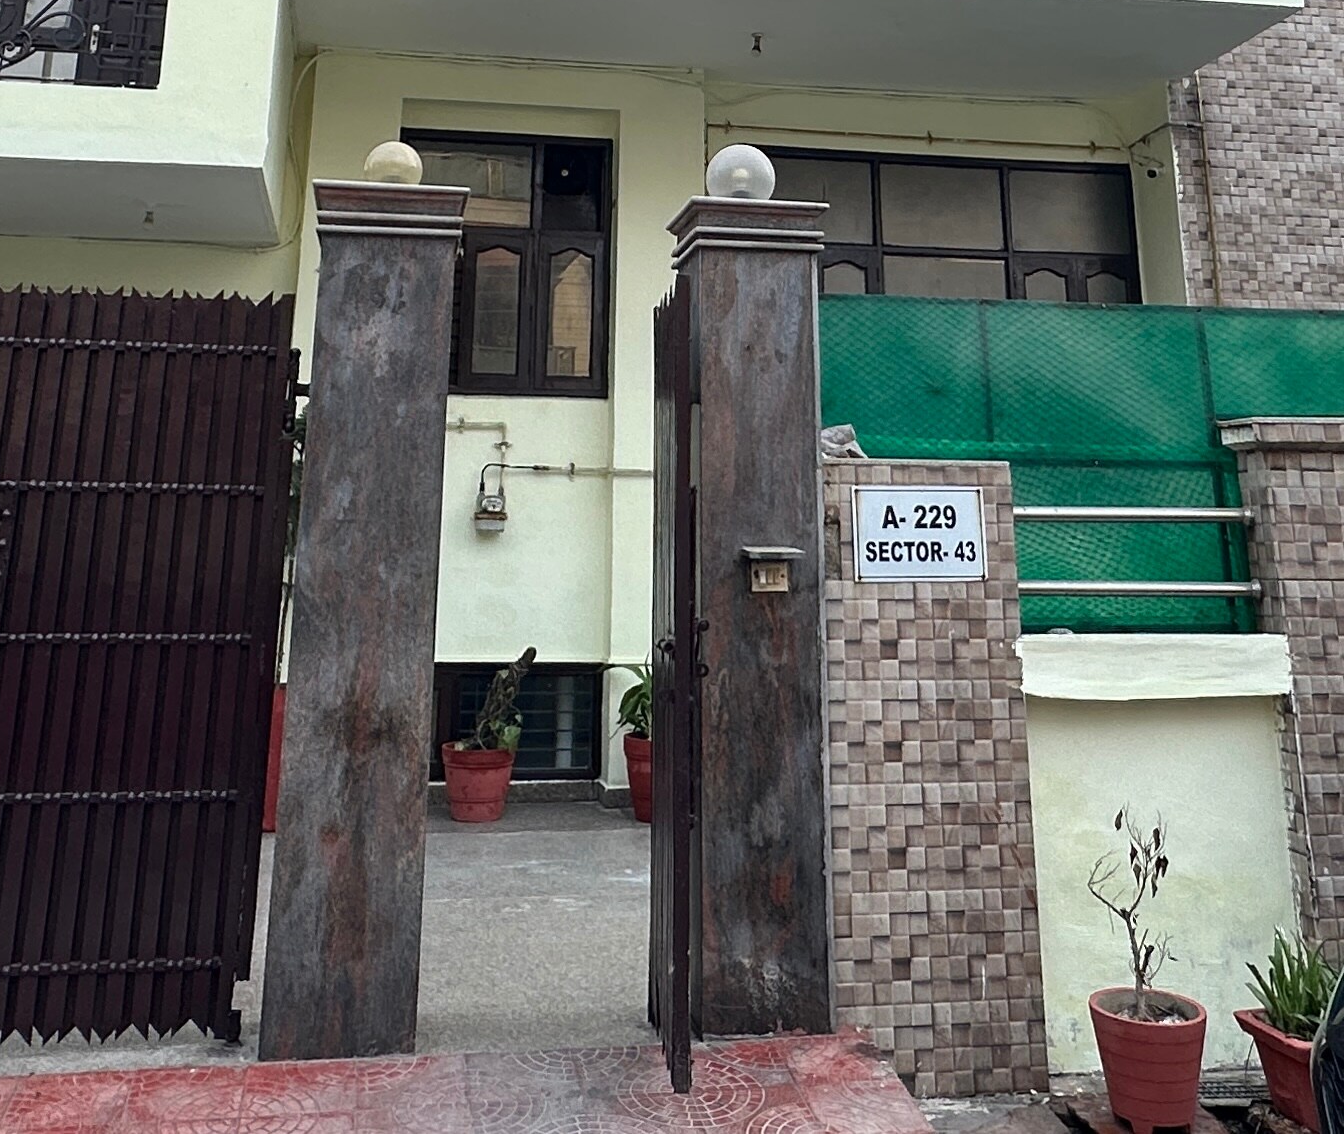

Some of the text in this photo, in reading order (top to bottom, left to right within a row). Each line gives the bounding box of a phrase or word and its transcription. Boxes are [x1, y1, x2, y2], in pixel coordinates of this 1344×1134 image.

[881, 504, 958, 530] A- 229
[865, 540, 977, 563] SECTOR- 43
